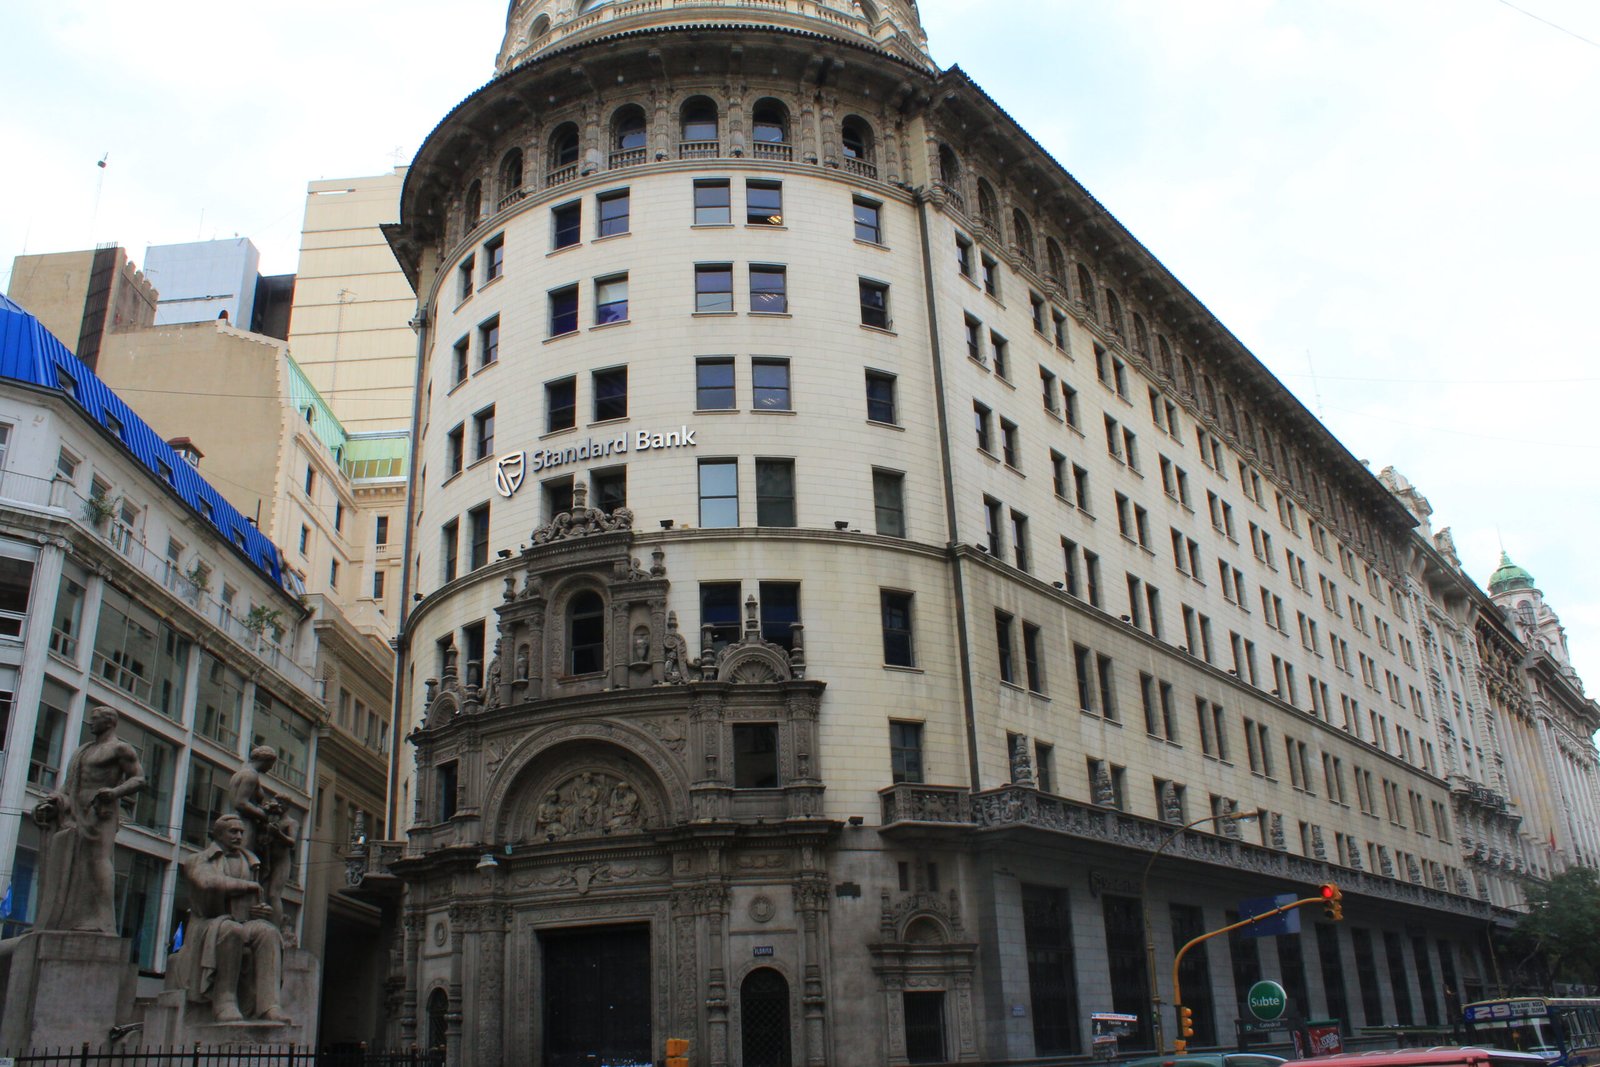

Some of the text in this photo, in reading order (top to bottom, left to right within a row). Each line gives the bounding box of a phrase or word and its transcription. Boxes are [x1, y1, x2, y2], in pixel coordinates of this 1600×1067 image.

[533, 425, 696, 472] Standard Bank
[1251, 996, 1280, 1007] Subte
[1474, 1004, 1511, 1019] 29
